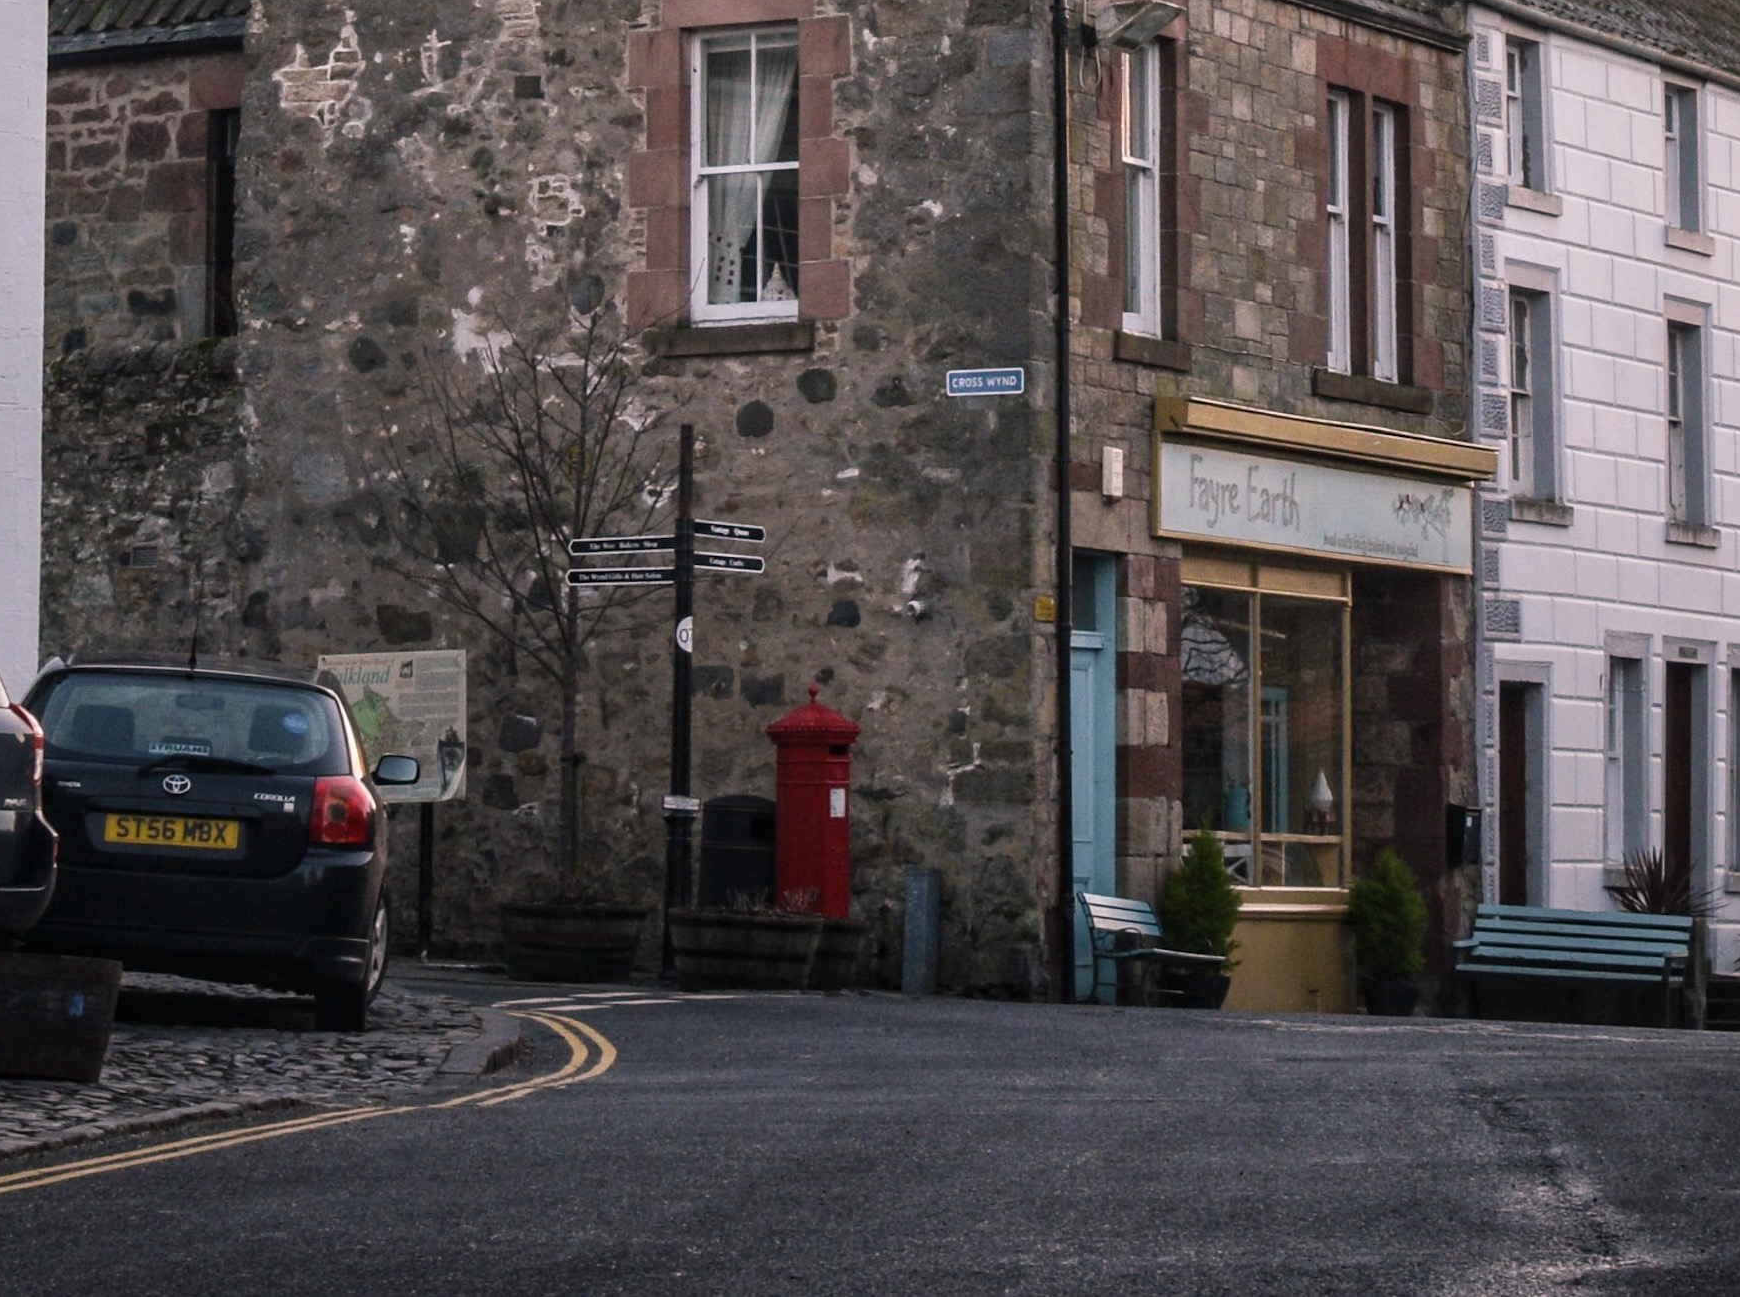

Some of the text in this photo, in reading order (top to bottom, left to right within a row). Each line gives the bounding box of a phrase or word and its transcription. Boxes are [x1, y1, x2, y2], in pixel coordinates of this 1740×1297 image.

[951, 376, 1017, 388] CROSS WYND
[1189, 453, 1301, 533] Fayre Earth
[333, 665, 392, 685] alkland
[253, 792, 296, 802] COROLLA
[116, 817, 227, 844] ST56 MBX
